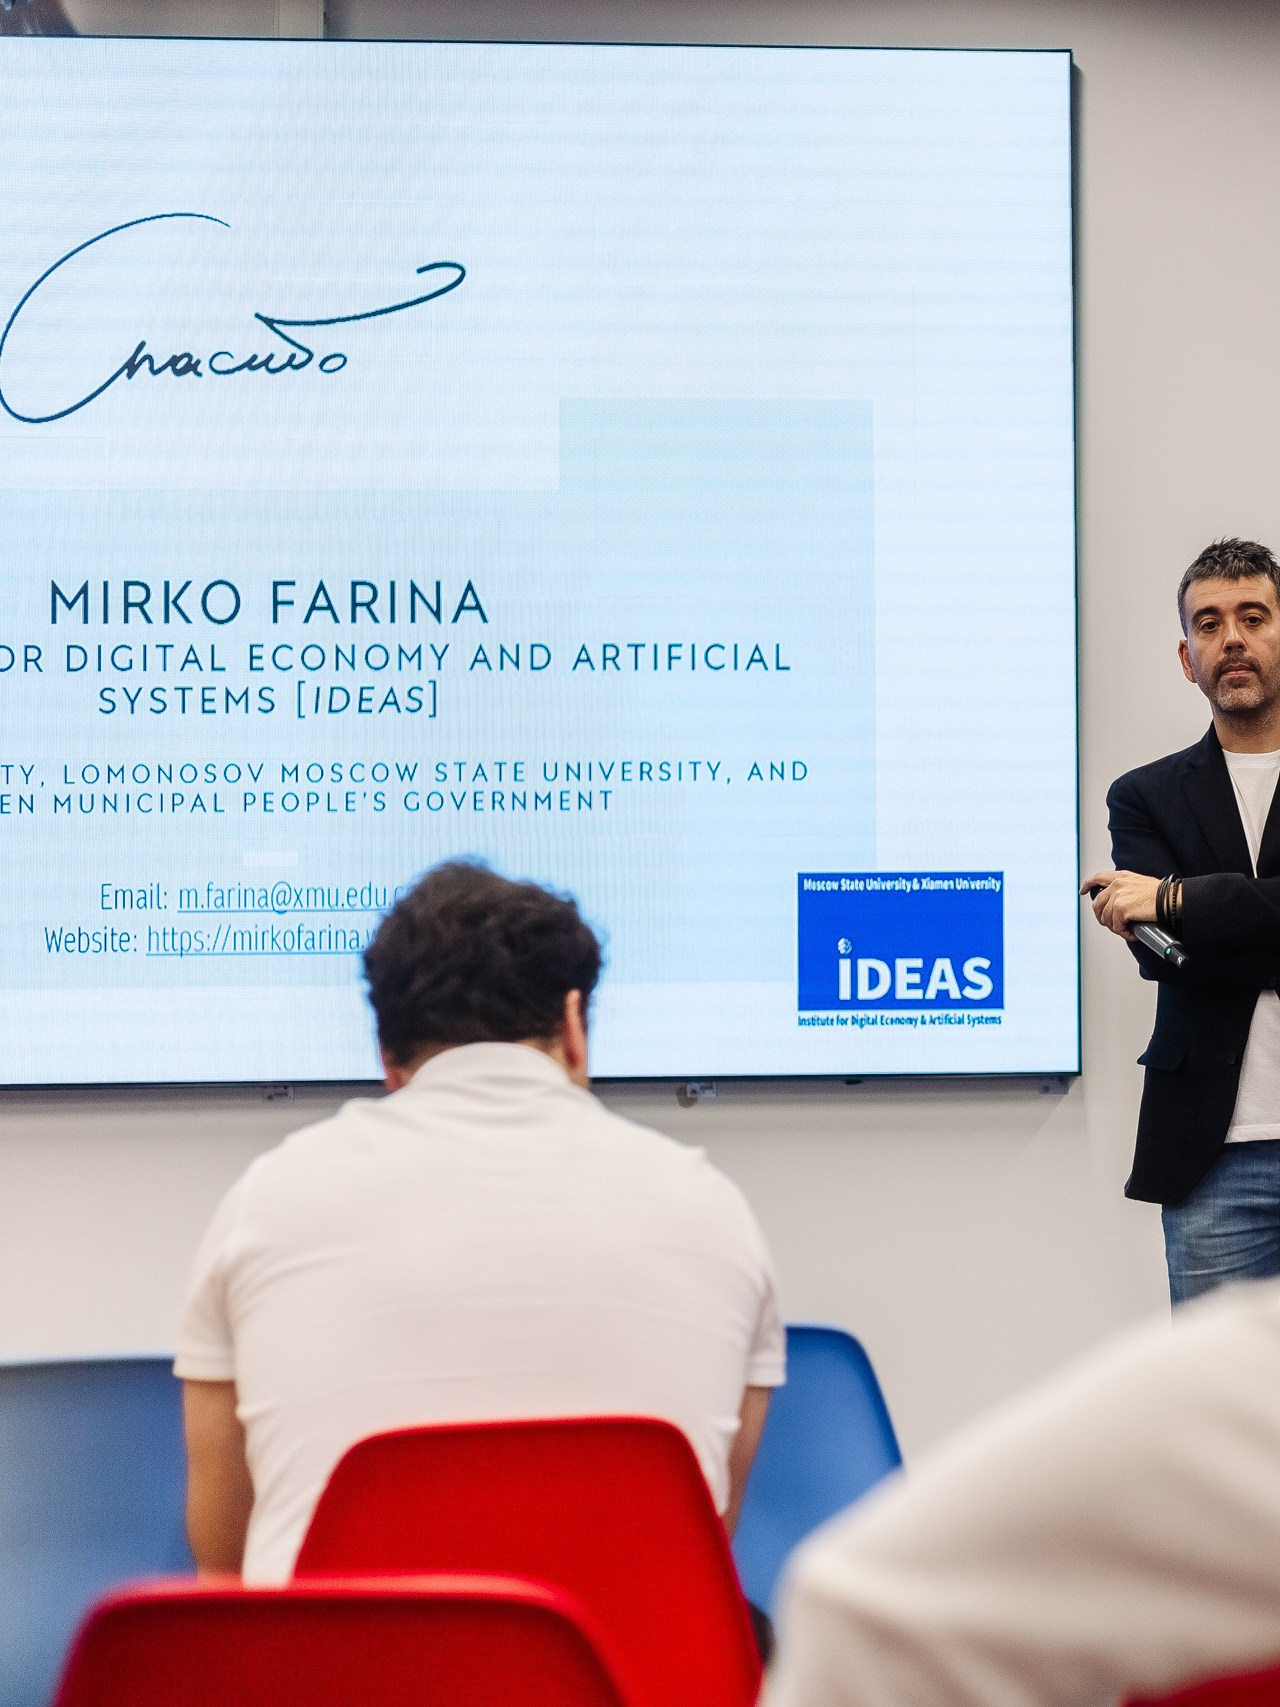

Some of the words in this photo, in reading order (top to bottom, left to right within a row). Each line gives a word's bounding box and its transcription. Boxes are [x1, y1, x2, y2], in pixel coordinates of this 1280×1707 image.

[0, 212, 467, 424] Спасибо
[50, 579, 241, 625] MIRKO
[271, 579, 489, 625] FARINA
[66, 644, 227, 673] DIGITAL
[248, 643, 450, 672] ECONOMY
[469, 643, 552, 671] AND
[572, 643, 792, 671] ARTIFICIAL
[98, 686, 277, 715] SYSTEMS
[297, 680, 438, 719] [IDEAS]
[0, 764, 46, 788] TY,
[63, 763, 264, 785] LOMONOSOV
[281, 763, 419, 784] MOSCOW
[435, 762, 526, 783] STATE
[543, 761, 733, 785] UNIVERSITY,
[747, 761, 809, 782] AND
[0, 793, 35, 815] EN
[53, 793, 226, 814] MUNICIPAL
[243, 792, 388, 813] PEOPLE'S
[403, 791, 614, 812] GOVERNMENT
[100, 883, 168, 910] Email:
[803, 878, 839, 892] Moscow
[840, 877, 865, 891] State
[865, 876, 911, 893] University
[912, 878, 920, 891] &
[921, 877, 955, 890] Xiamen
[955, 876, 1002, 893] University
[44, 926, 138, 953] Website:
[798, 1014, 835, 1027] Institute
[836, 1013, 850, 1026] for
[851, 1013, 878, 1029] Digital
[880, 1013, 919, 1028] Economy
[920, 1014, 927, 1026] &
[928, 1012, 965, 1025] Artificial
[967, 1012, 1003, 1027] Systems
